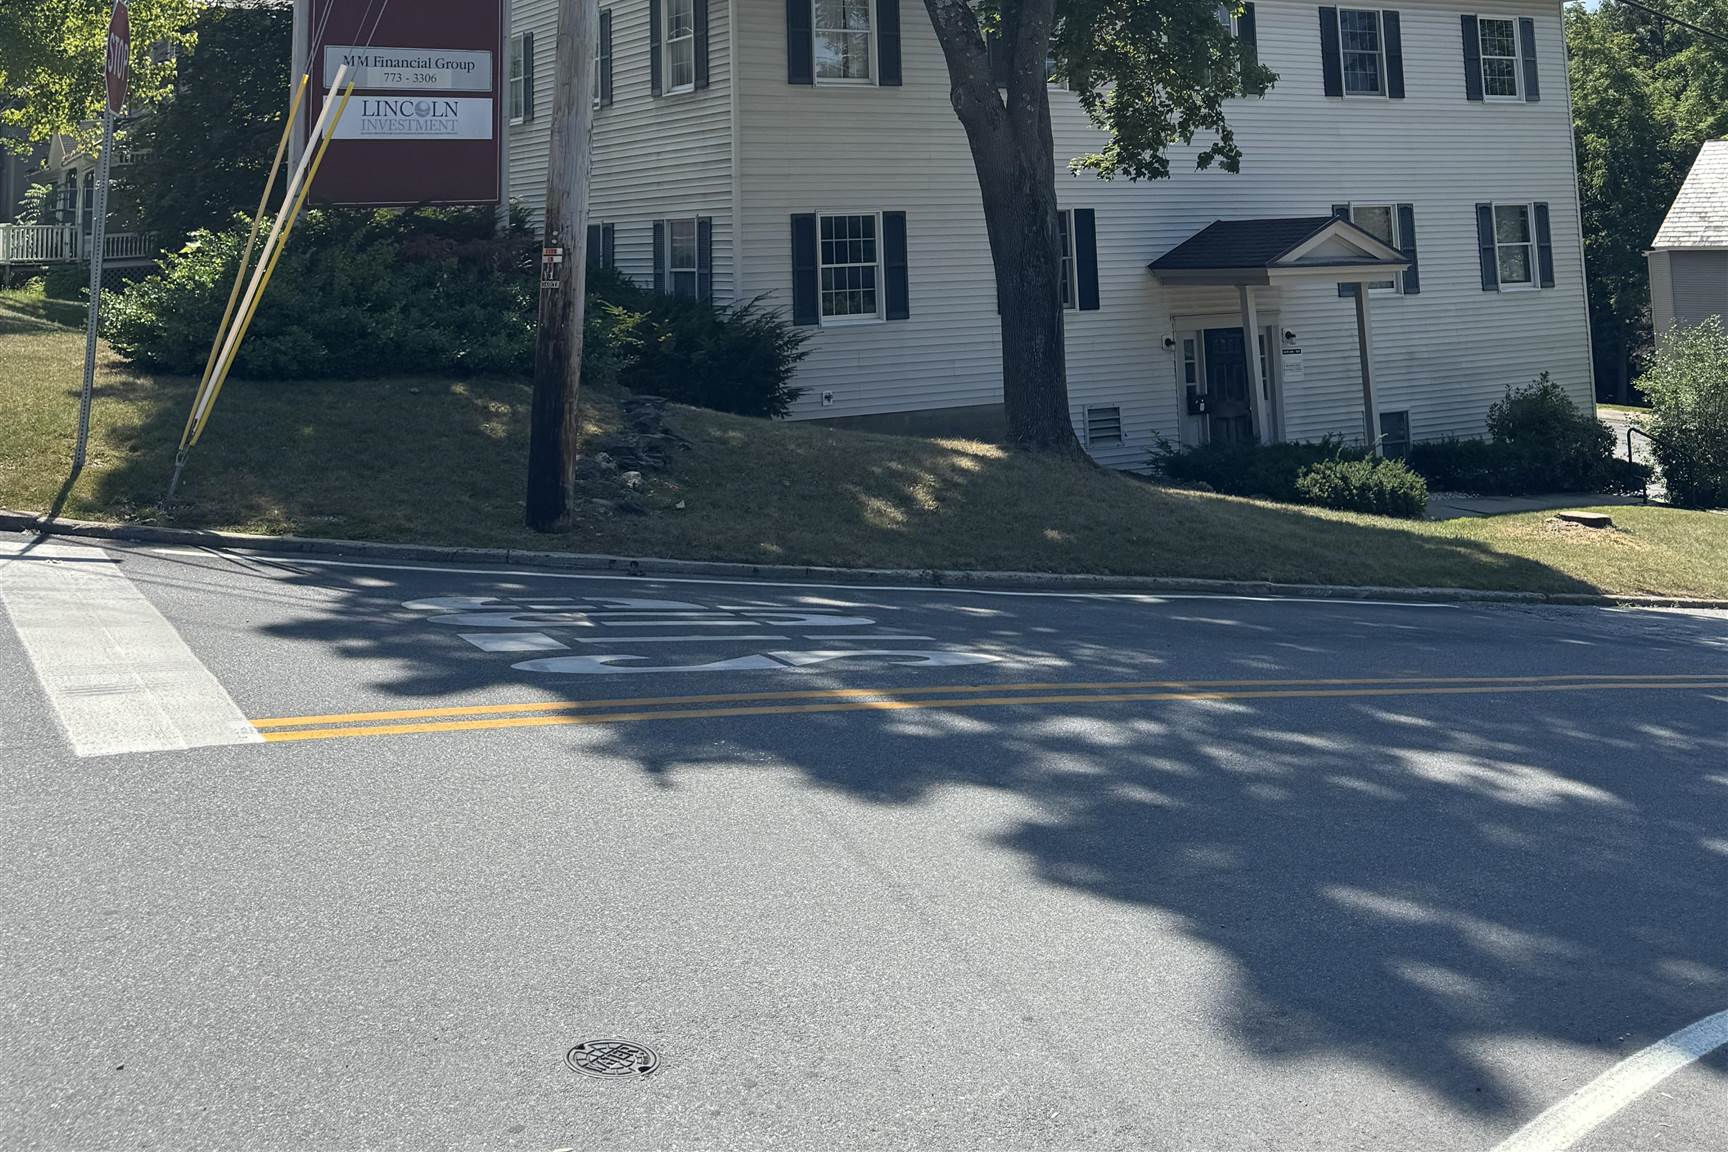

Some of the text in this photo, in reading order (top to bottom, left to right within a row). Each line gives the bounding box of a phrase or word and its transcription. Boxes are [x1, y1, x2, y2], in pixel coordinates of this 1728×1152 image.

[108, 33, 129, 80] STOP
[373, 55, 432, 69] Financial
[435, 57, 476, 73] Group
[384, 72, 402, 83] 773
[413, 73, 437, 84] 3306
[361, 99, 459, 118] LINCOLN
[361, 118, 459, 132] INVESTMENT
[401, 596, 1002, 674] STOP
